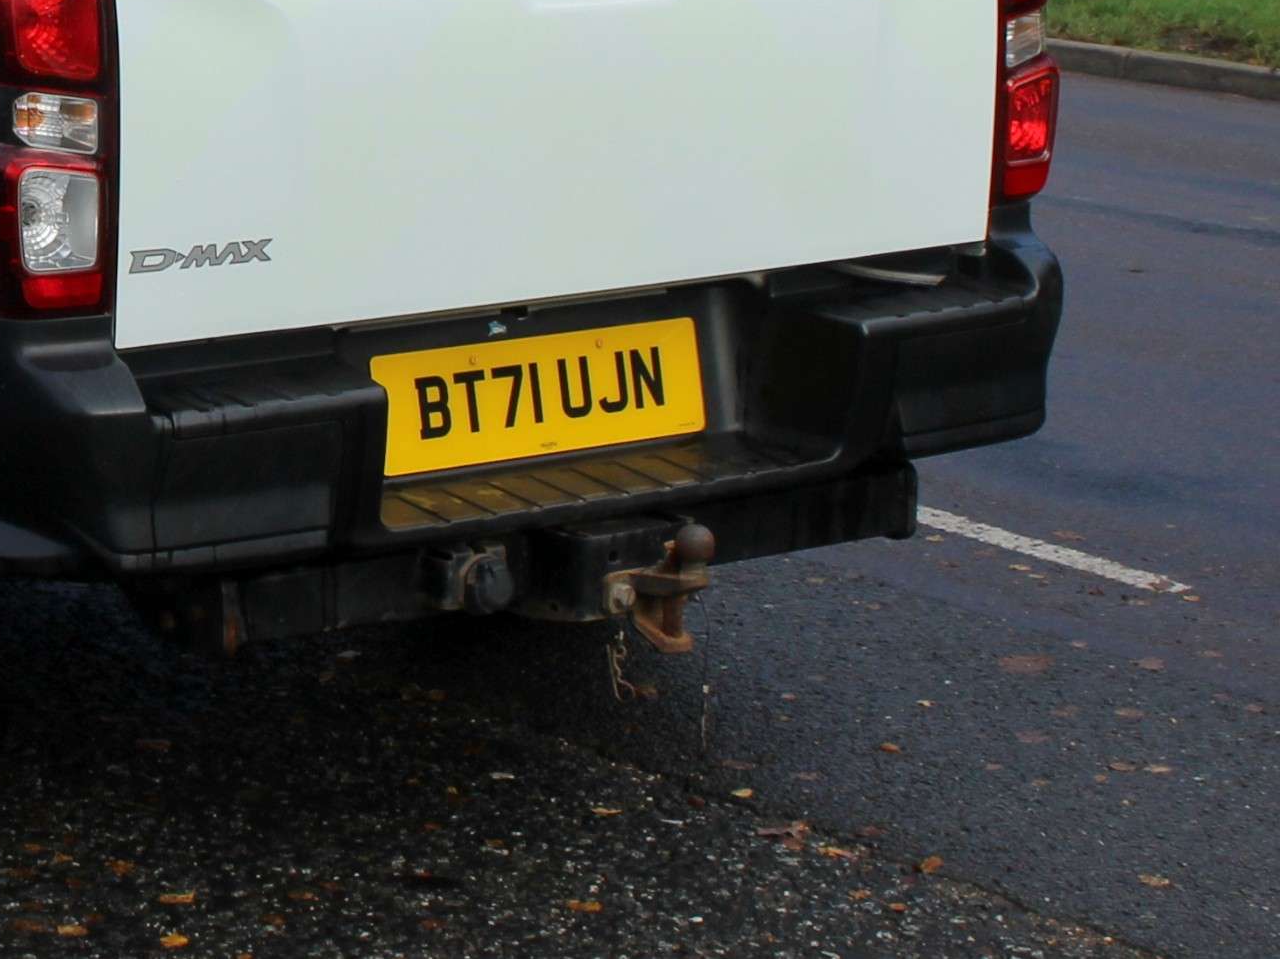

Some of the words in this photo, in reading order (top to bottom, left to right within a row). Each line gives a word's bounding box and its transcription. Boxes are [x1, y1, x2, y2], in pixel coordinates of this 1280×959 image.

[128, 238, 273, 274] D-MAX
[414, 362, 544, 440] BT71
[556, 346, 665, 418] UJN
